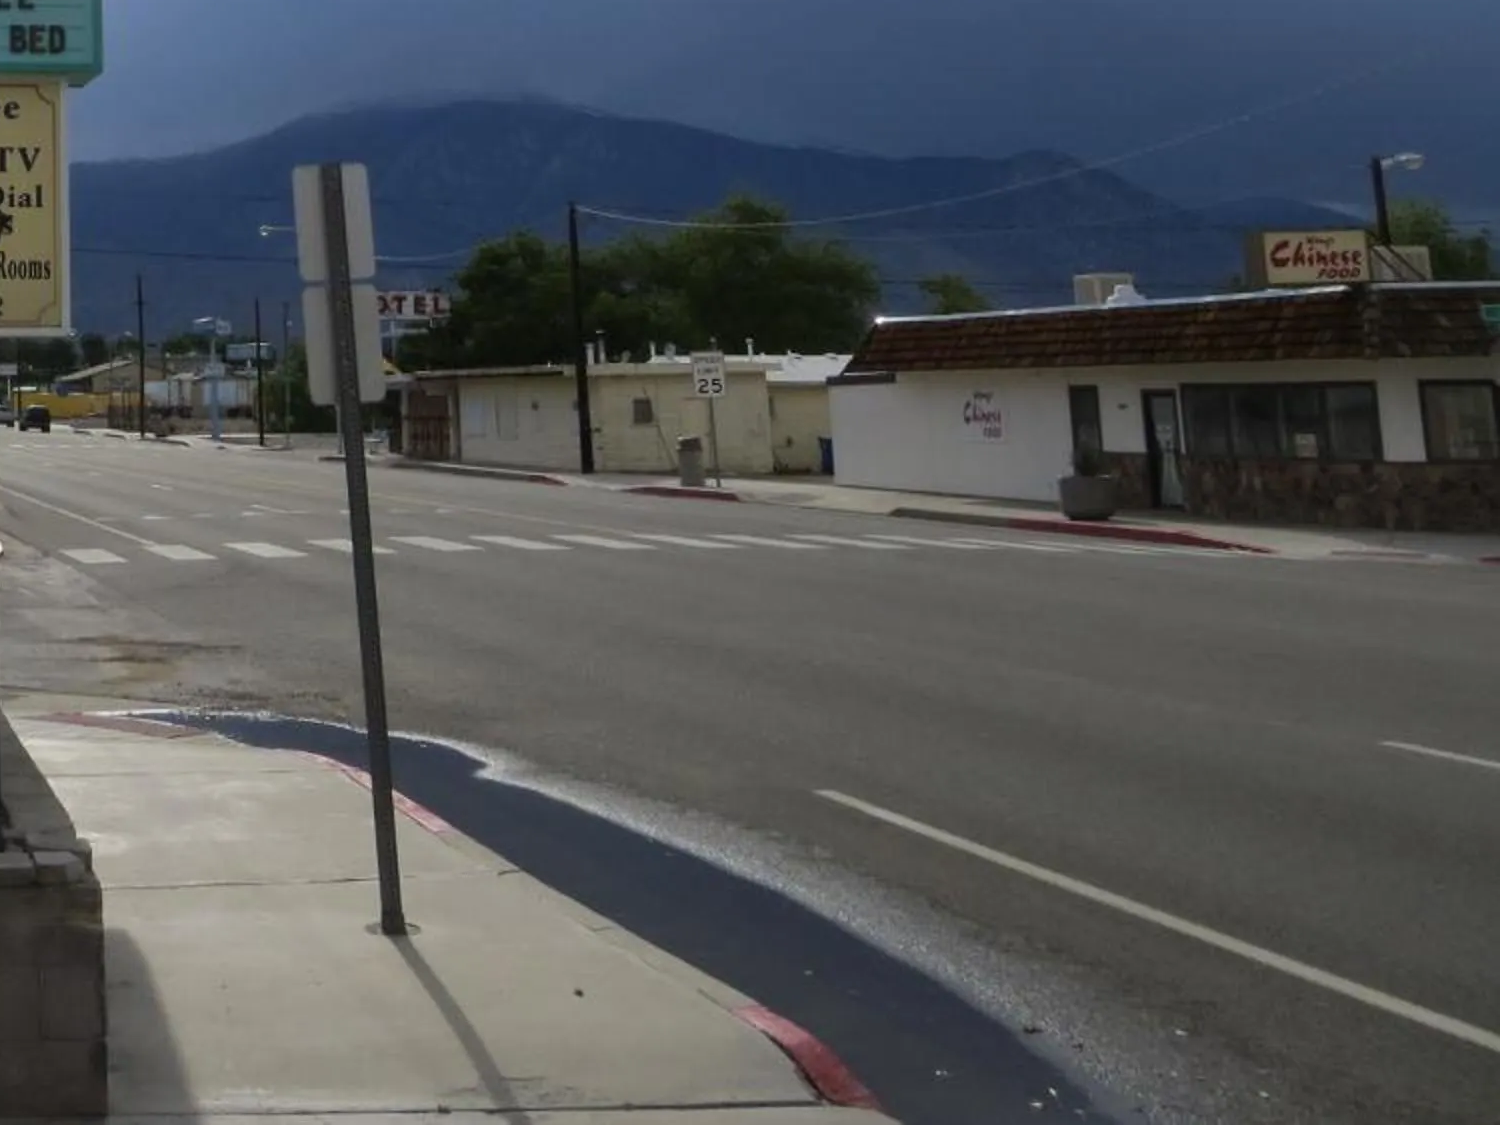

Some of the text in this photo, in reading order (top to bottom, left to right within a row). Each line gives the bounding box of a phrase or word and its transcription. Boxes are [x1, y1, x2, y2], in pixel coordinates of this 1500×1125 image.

[9, 24, 66, 55] BED
[1269, 239, 1362, 268] Chinese
[697, 378, 723, 394] 25
